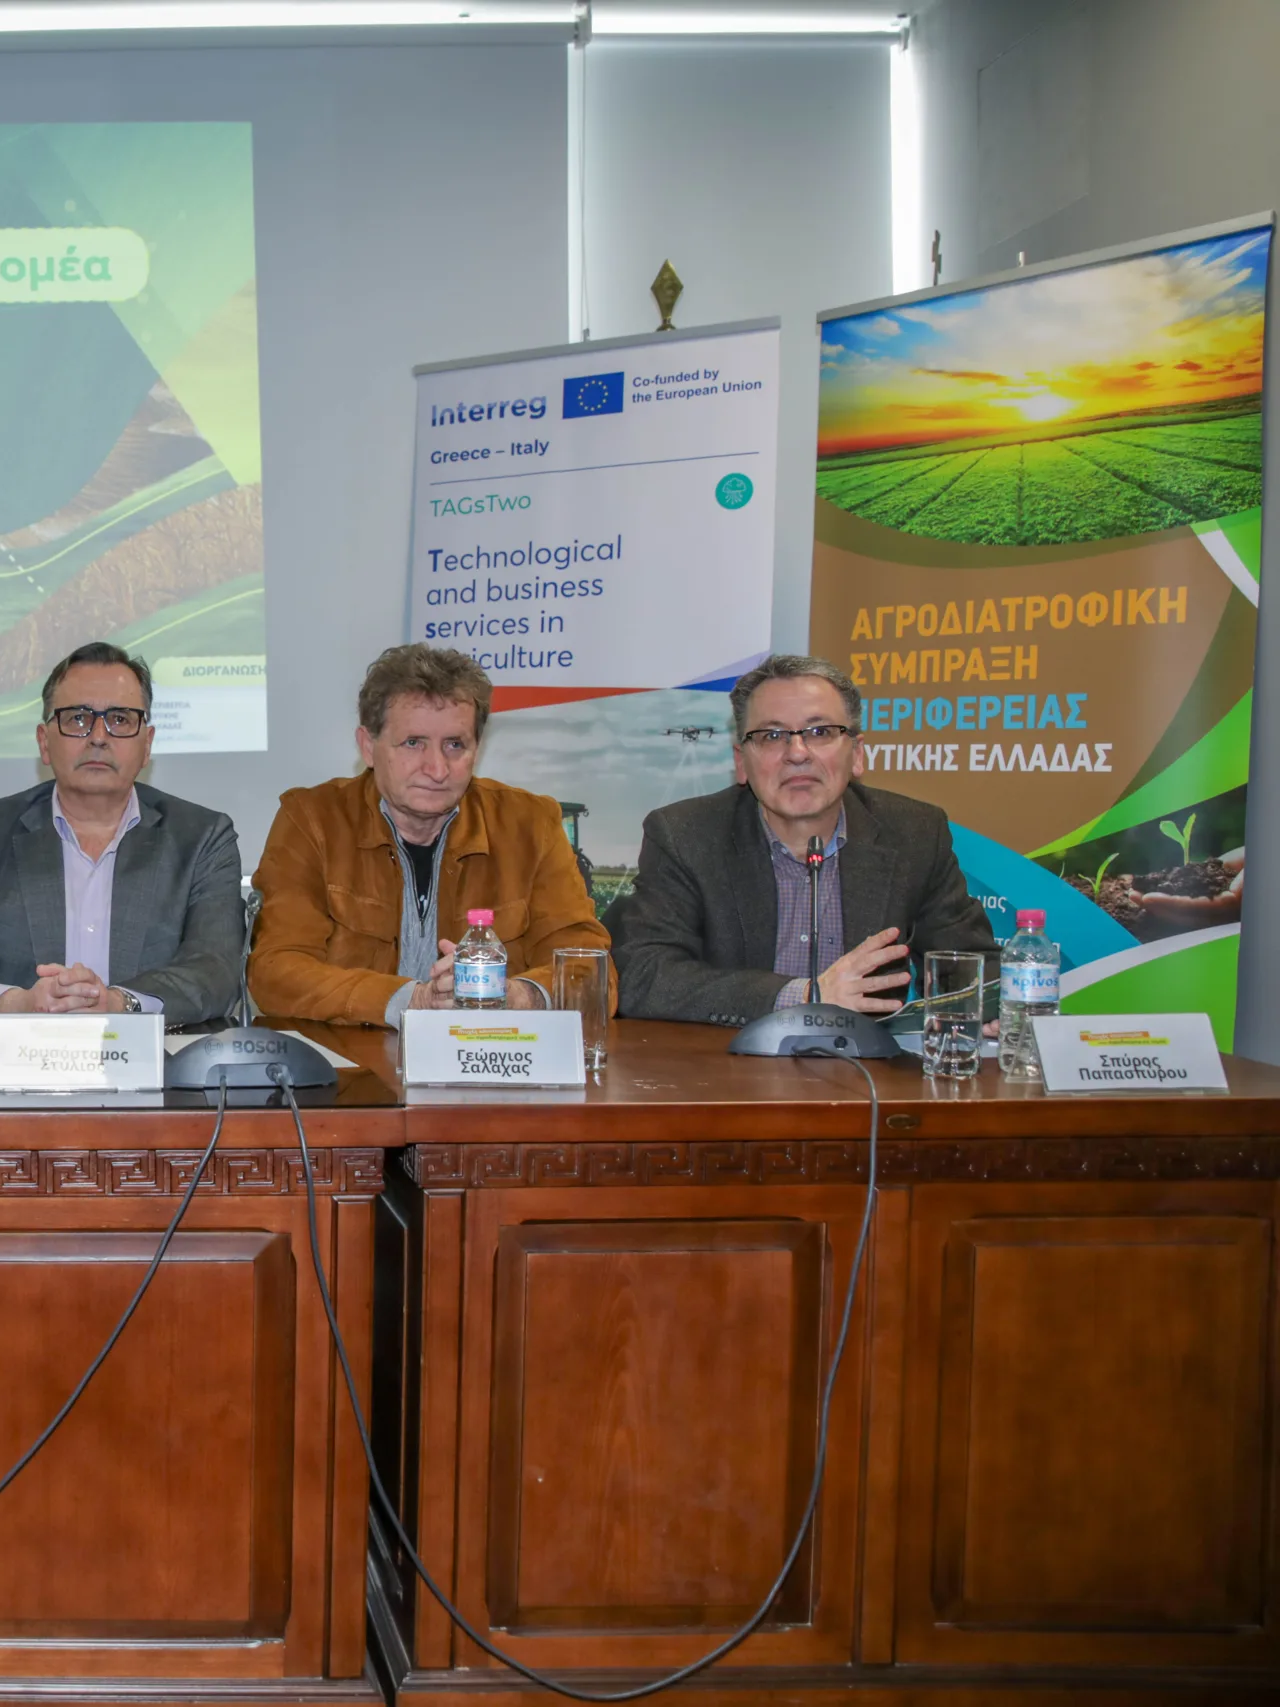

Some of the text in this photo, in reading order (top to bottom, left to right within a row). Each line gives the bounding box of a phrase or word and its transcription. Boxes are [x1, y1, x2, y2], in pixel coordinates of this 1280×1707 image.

[632, 368, 719, 389] Co-funded by
[632, 378, 763, 404] the European Union
[431, 394, 548, 428] Interreg
[430, 446, 491, 465] Greece
[511, 439, 550, 457] Italy
[430, 493, 532, 518] TAGsTwo
[428, 533, 623, 573] Technological
[426, 576, 604, 606] and business
[425, 609, 564, 639] services in
[850, 586, 1188, 641] ΑΓΡΟΔΙΑΤΡΟΦΙΚΗ
[471, 643, 573, 670] iculture
[849, 645, 1039, 686] ΣΥΜΠΡΑΞΗ
[182, 664, 267, 678] ΔΙΟΡΓΑΝΩΣΗ
[864, 743, 1113, 772] ΥΤΙΚΗΣ ΕΛΛΑΔΑΣ
[803, 1014, 856, 1029] BOSCH
[232, 1040, 288, 1054] BOSCH
[457, 1048, 533, 1066] Γεώργιος
[460, 1060, 530, 1077] Σαλάχας
[1078, 1065, 1188, 1082] Παπασπύρου
[1099, 1054, 1161, 1070] Σπύρος
